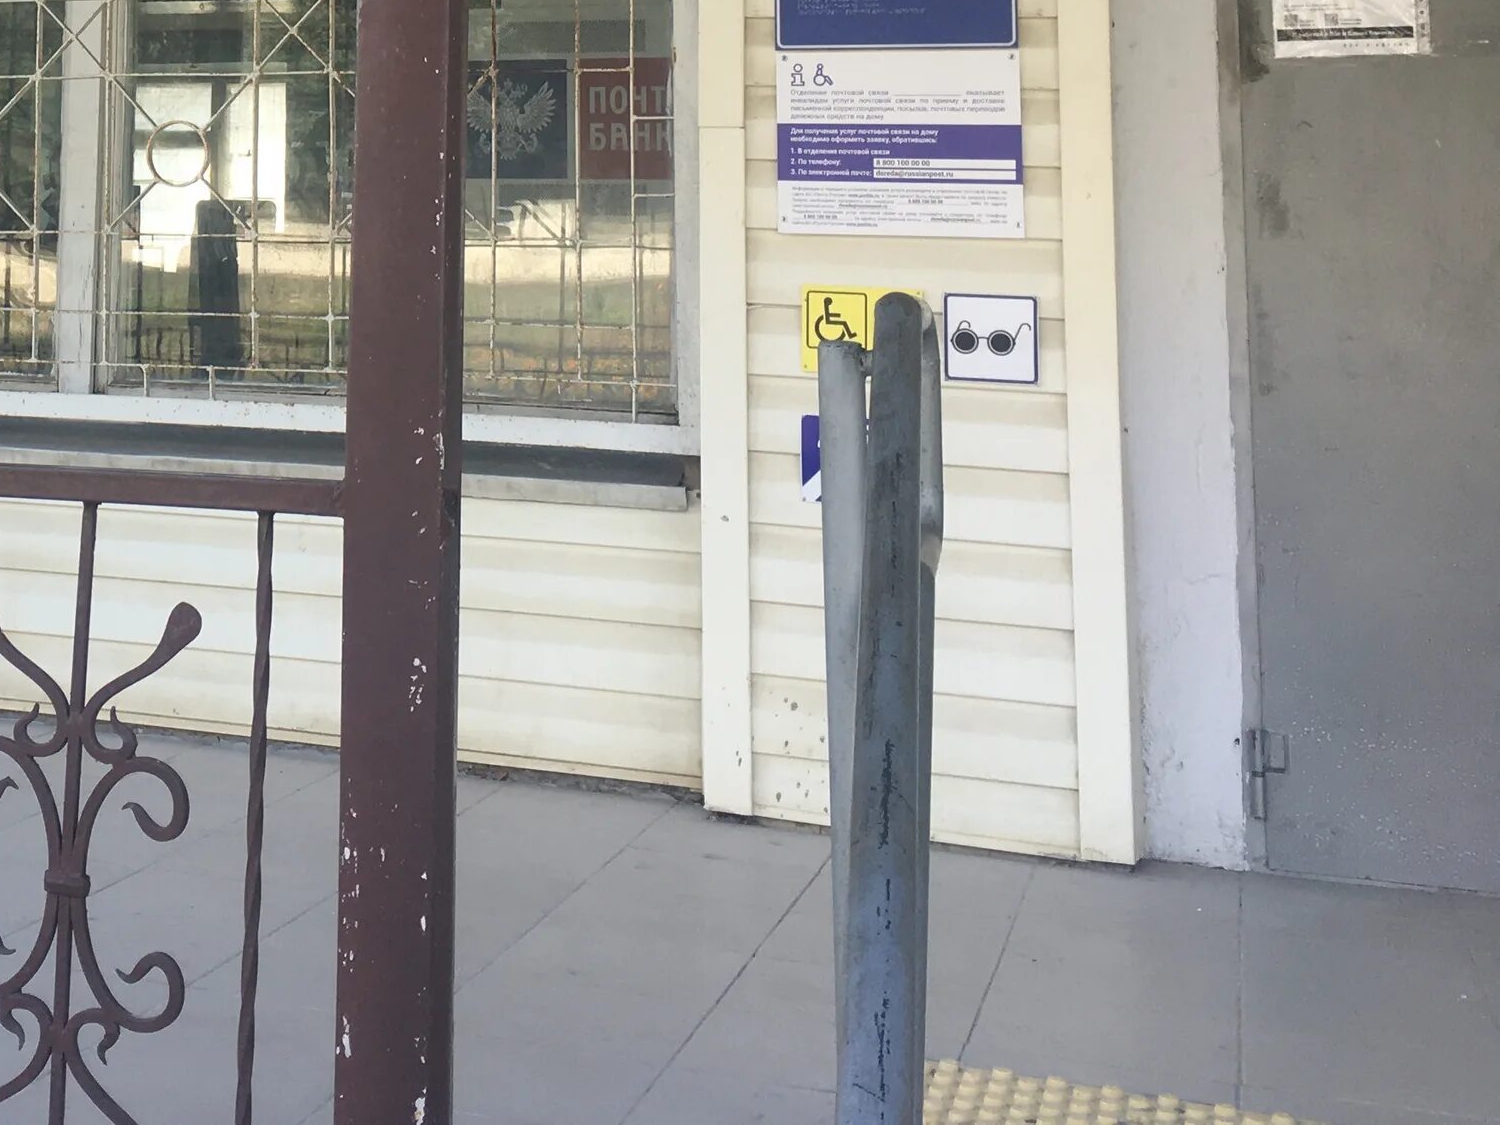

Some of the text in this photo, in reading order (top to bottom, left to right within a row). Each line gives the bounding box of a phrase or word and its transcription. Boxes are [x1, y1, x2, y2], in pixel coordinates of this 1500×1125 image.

[588, 85, 668, 115] ПОЧТ
[831, 135, 866, 144] оформить
[838, 147, 870, 155] почтовой
[797, 157, 807, 165] По
